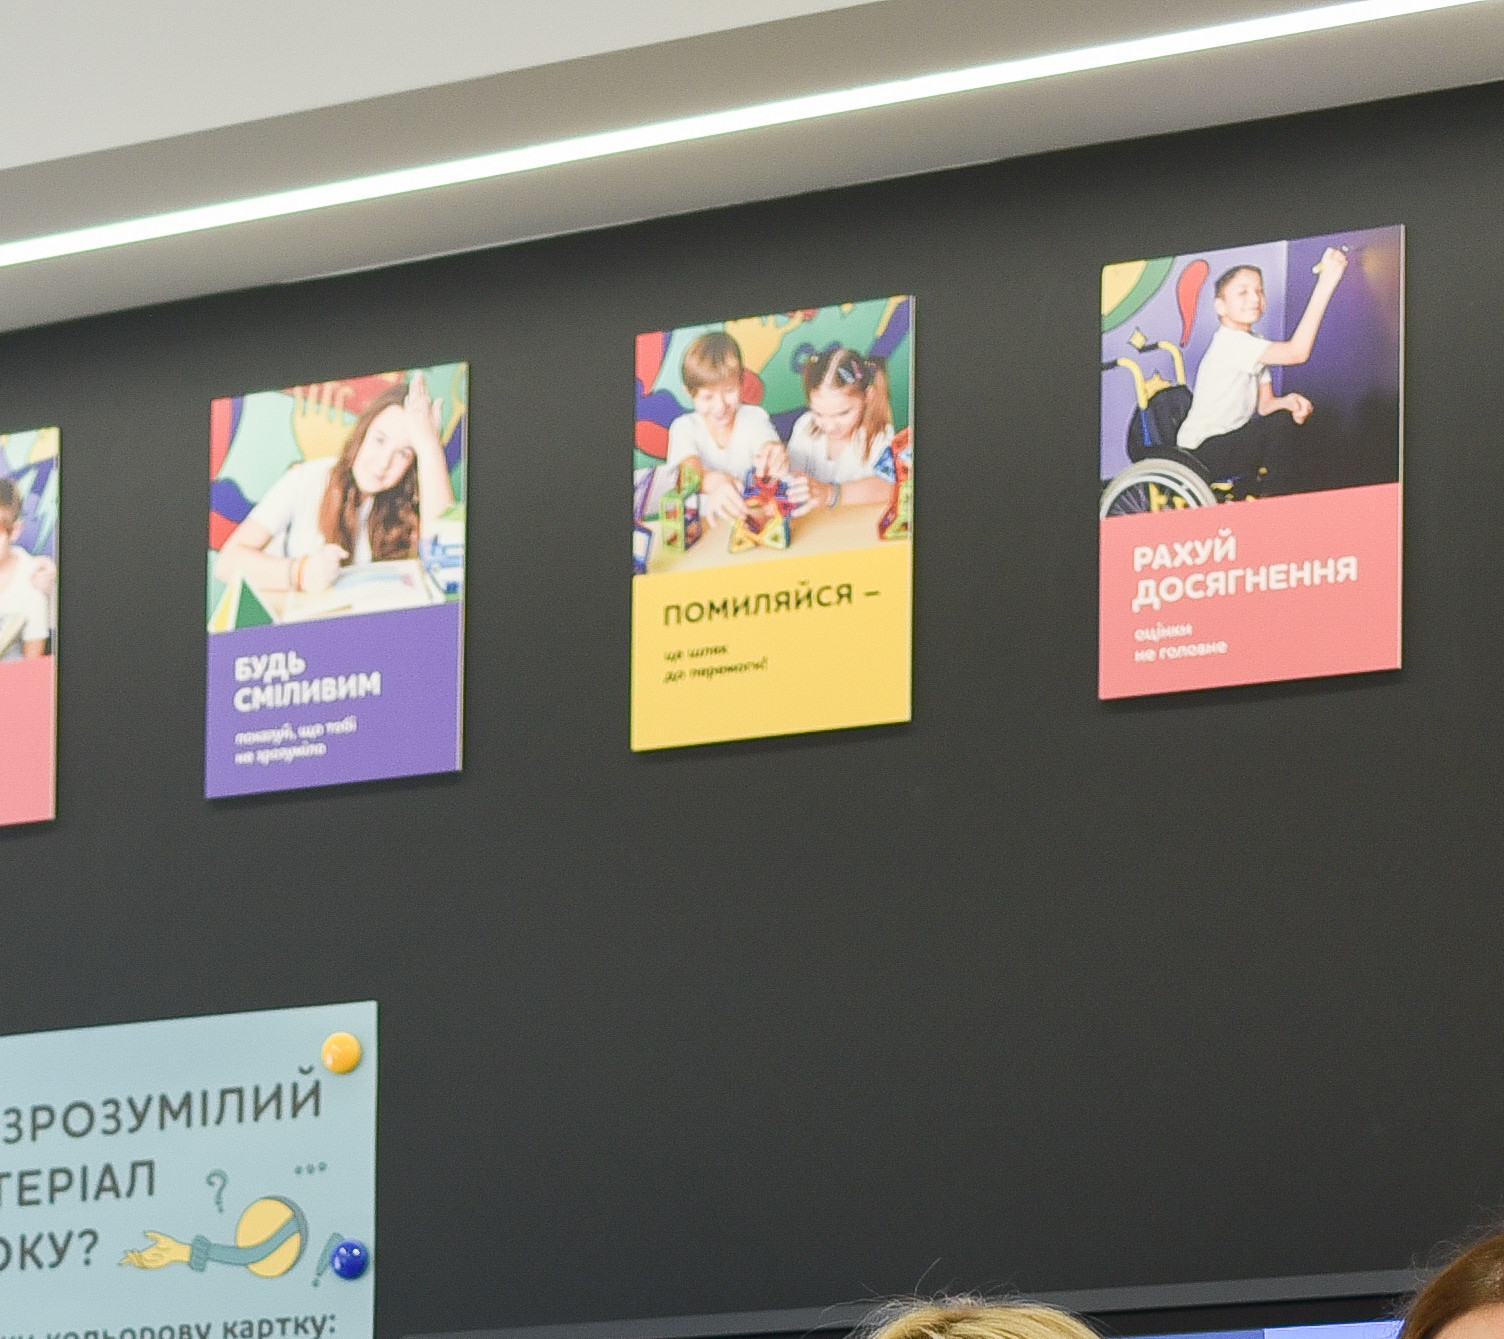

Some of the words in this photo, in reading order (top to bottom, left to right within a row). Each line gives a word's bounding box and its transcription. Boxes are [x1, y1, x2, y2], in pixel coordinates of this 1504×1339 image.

[1133, 528, 1237, 573] РАХУЙ
[664, 580, 853, 626] ПОМИЛЯЙСЯ
[1132, 556, 1359, 614] ДОСЯГНЕННЯ
[1134, 622, 1193, 643] оцінки
[1134, 646, 1156, 663] не
[1159, 639, 1229, 660] головне
[234, 650, 307, 683] БУДЬ
[233, 671, 382, 713] СМІЛИВИМ
[2, 1064, 323, 1145] ЗРОЗУМІЛИЙ
